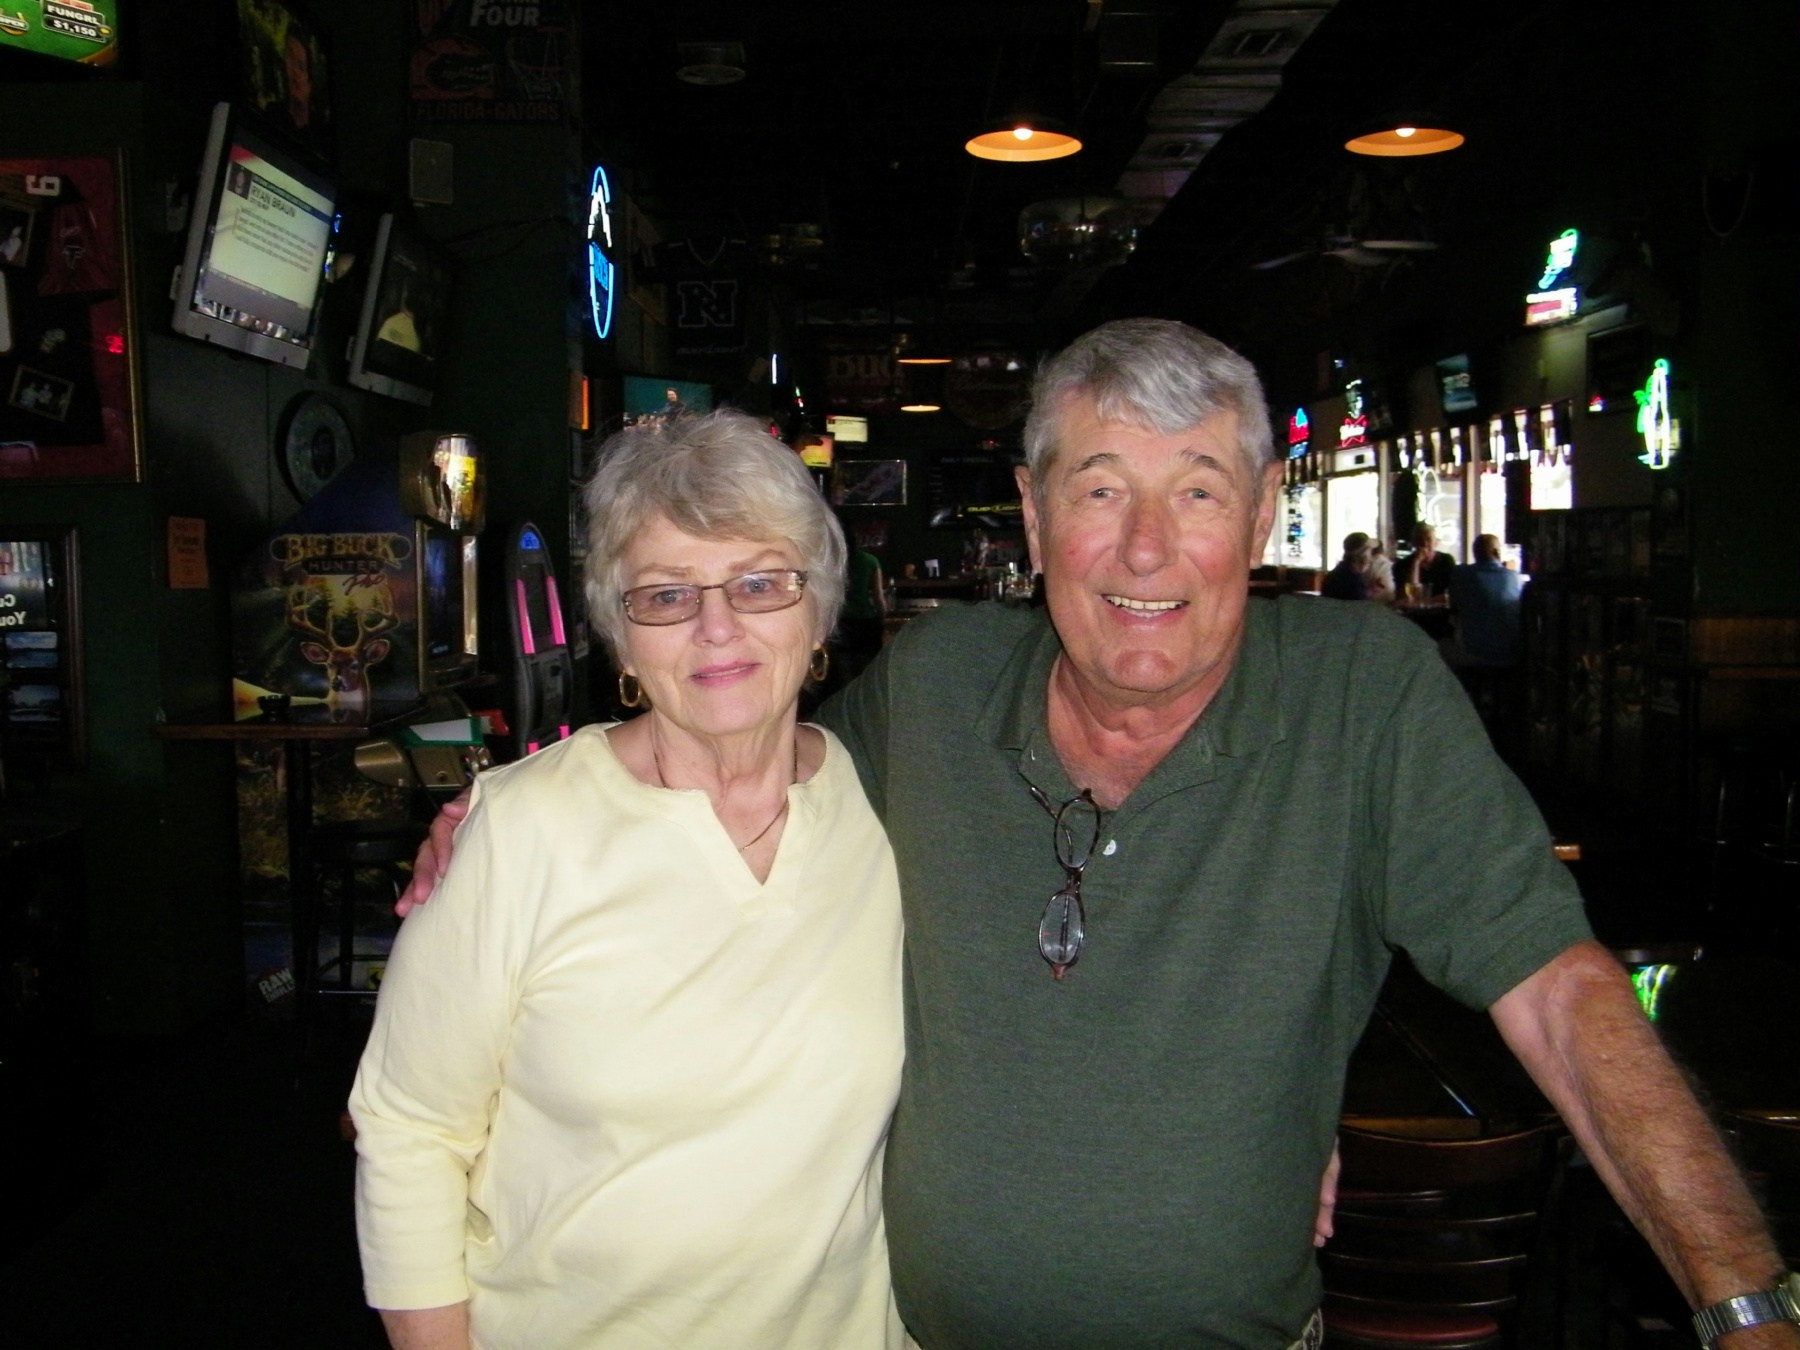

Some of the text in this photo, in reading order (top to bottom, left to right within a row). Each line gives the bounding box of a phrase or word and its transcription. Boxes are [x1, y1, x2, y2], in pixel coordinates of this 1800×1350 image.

[47, 5, 99, 24] FUNGRL
[469, 0, 541, 27] FOUR
[53, 20, 97, 37] $1,150
[286, 533, 397, 562] BIG BUCK
[308, 559, 378, 572] HUNTER
